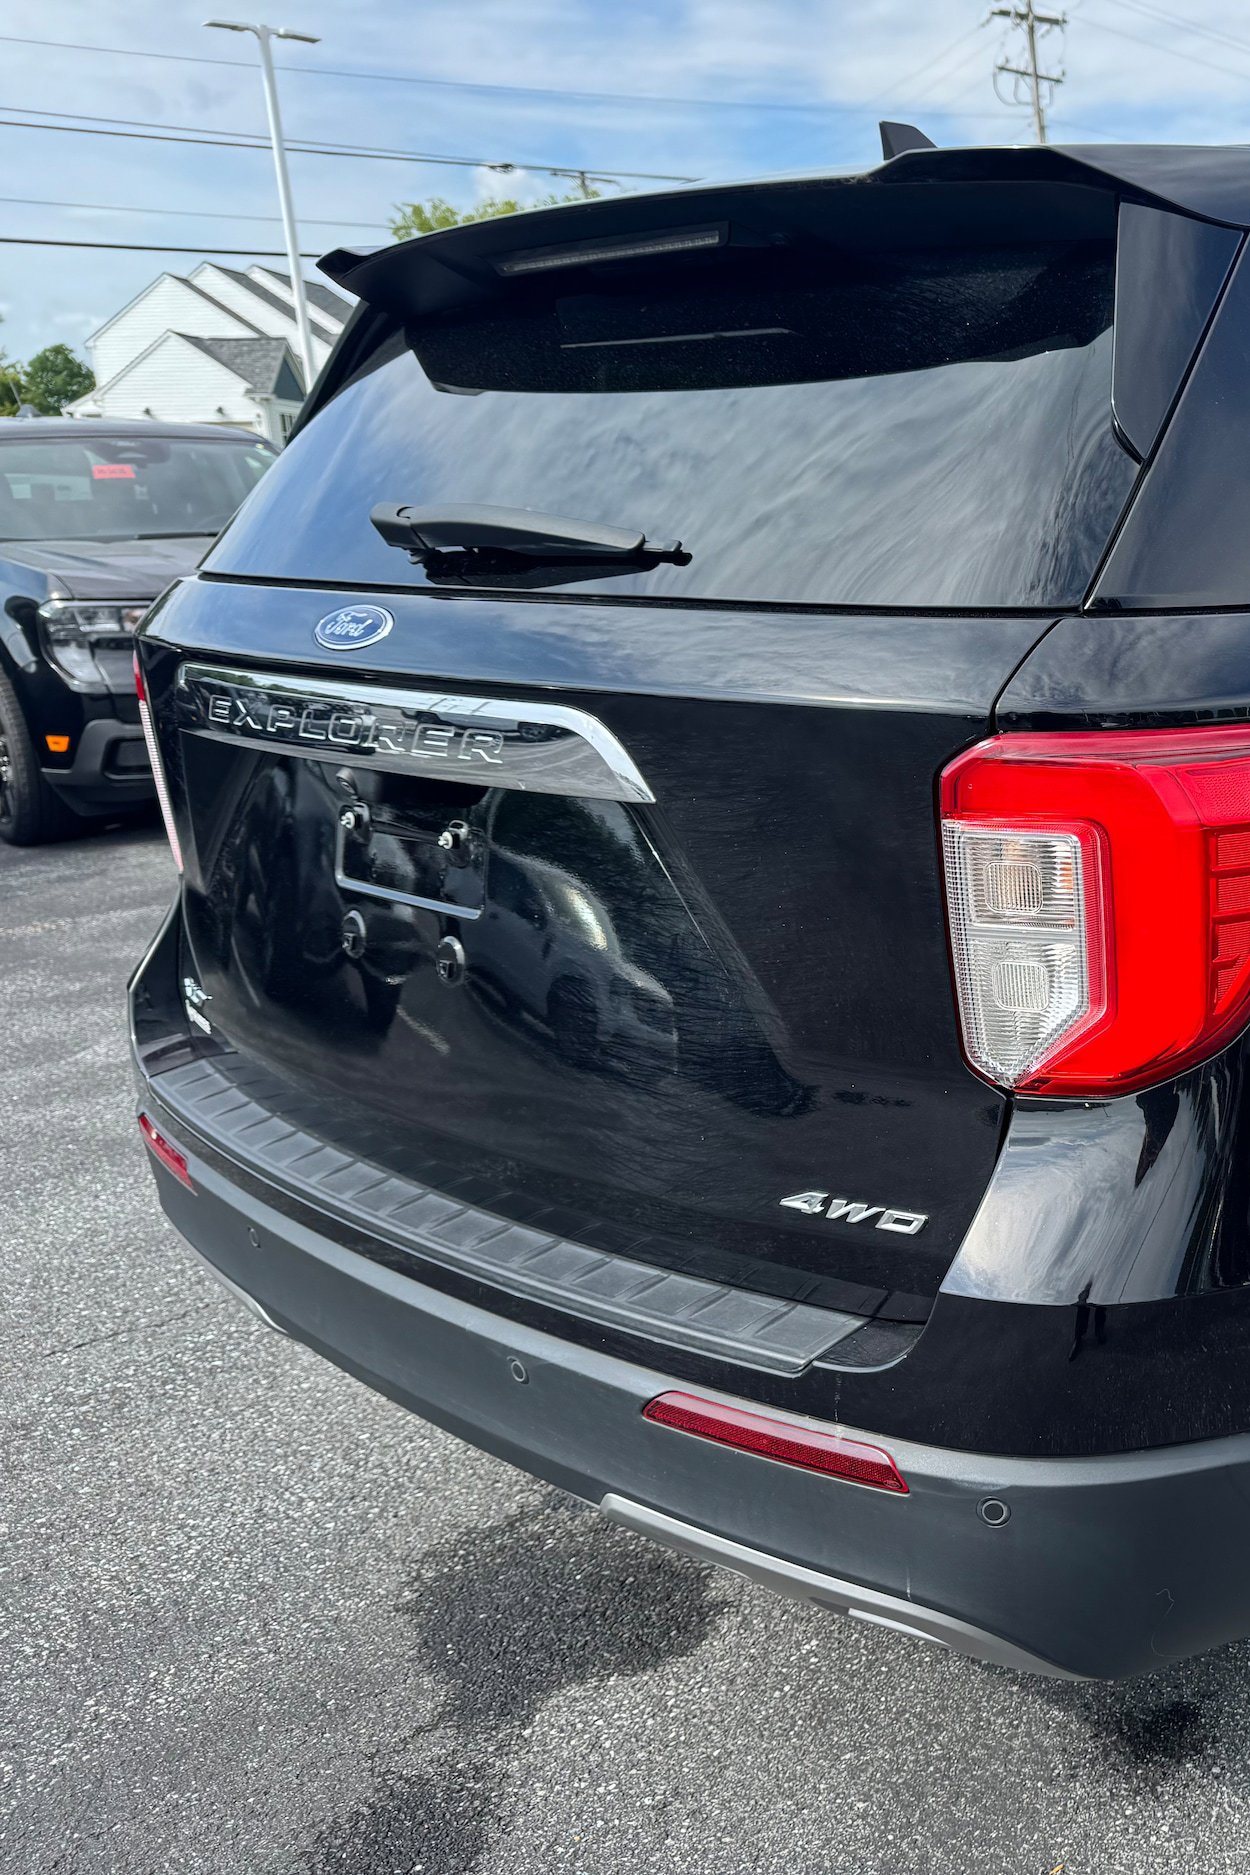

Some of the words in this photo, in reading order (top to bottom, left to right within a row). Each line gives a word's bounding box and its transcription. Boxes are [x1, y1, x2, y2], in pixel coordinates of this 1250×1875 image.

[324, 611, 373, 637] Ford
[207, 693, 505, 765] EXPLORER
[779, 1190, 929, 1236] 4WD
